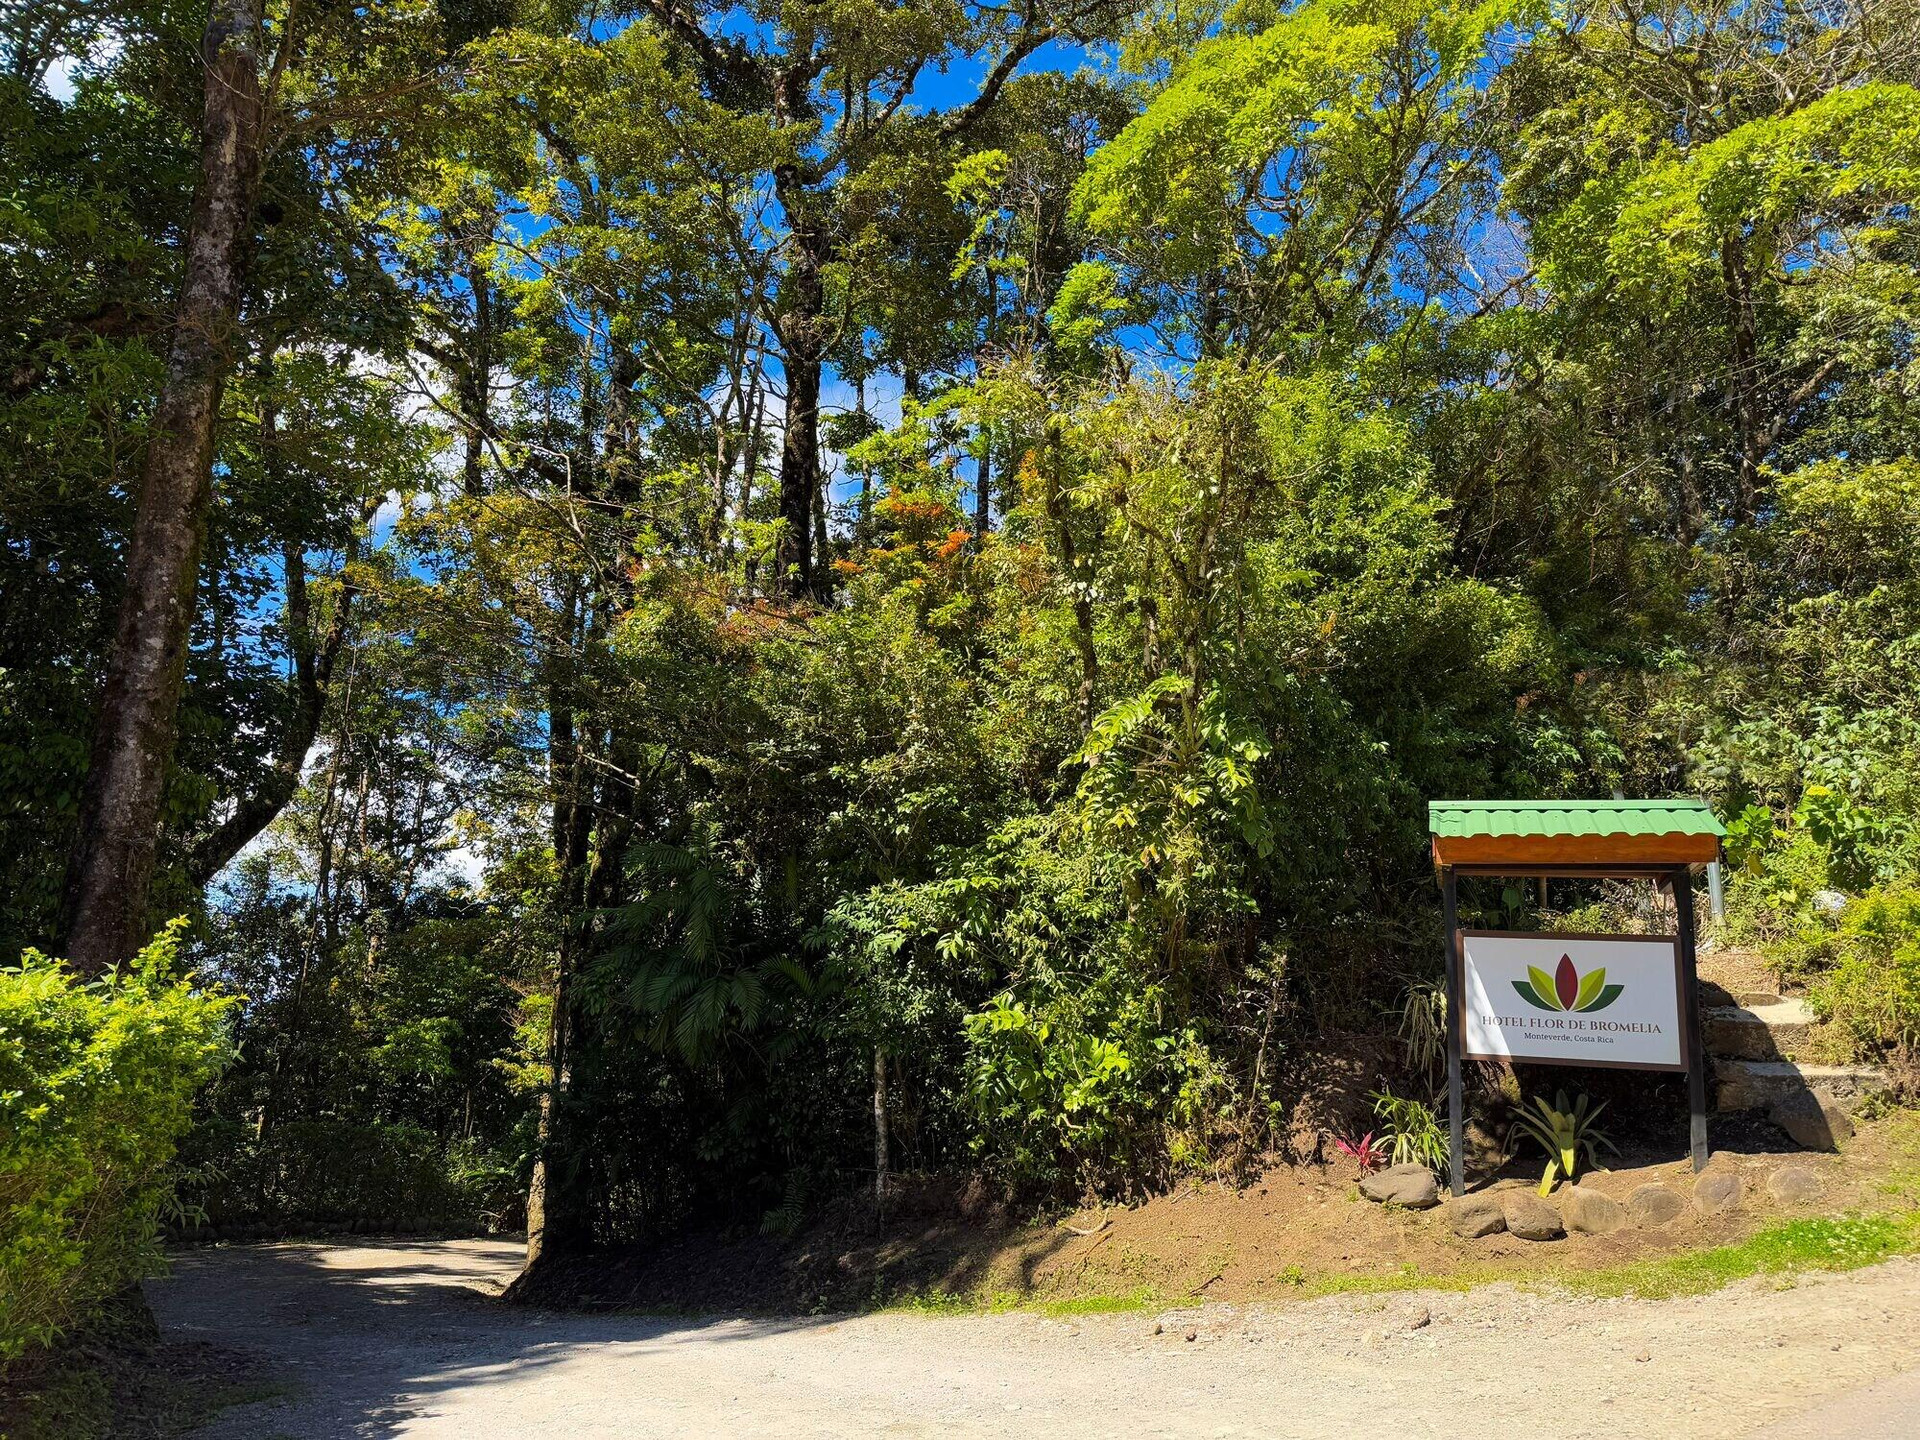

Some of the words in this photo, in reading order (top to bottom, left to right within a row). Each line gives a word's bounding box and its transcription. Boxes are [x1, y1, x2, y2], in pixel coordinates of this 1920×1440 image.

[1482, 1015, 1526, 1027] HOTEL
[1530, 1018, 1564, 1029] FLOR
[1568, 1020, 1586, 1030] DE
[1590, 1020, 1662, 1034] BROMELIA
[1524, 1032, 1573, 1042] Monteverde,
[1574, 1034, 1595, 1043] Costa
[1597, 1035, 1614, 1044] Rica
